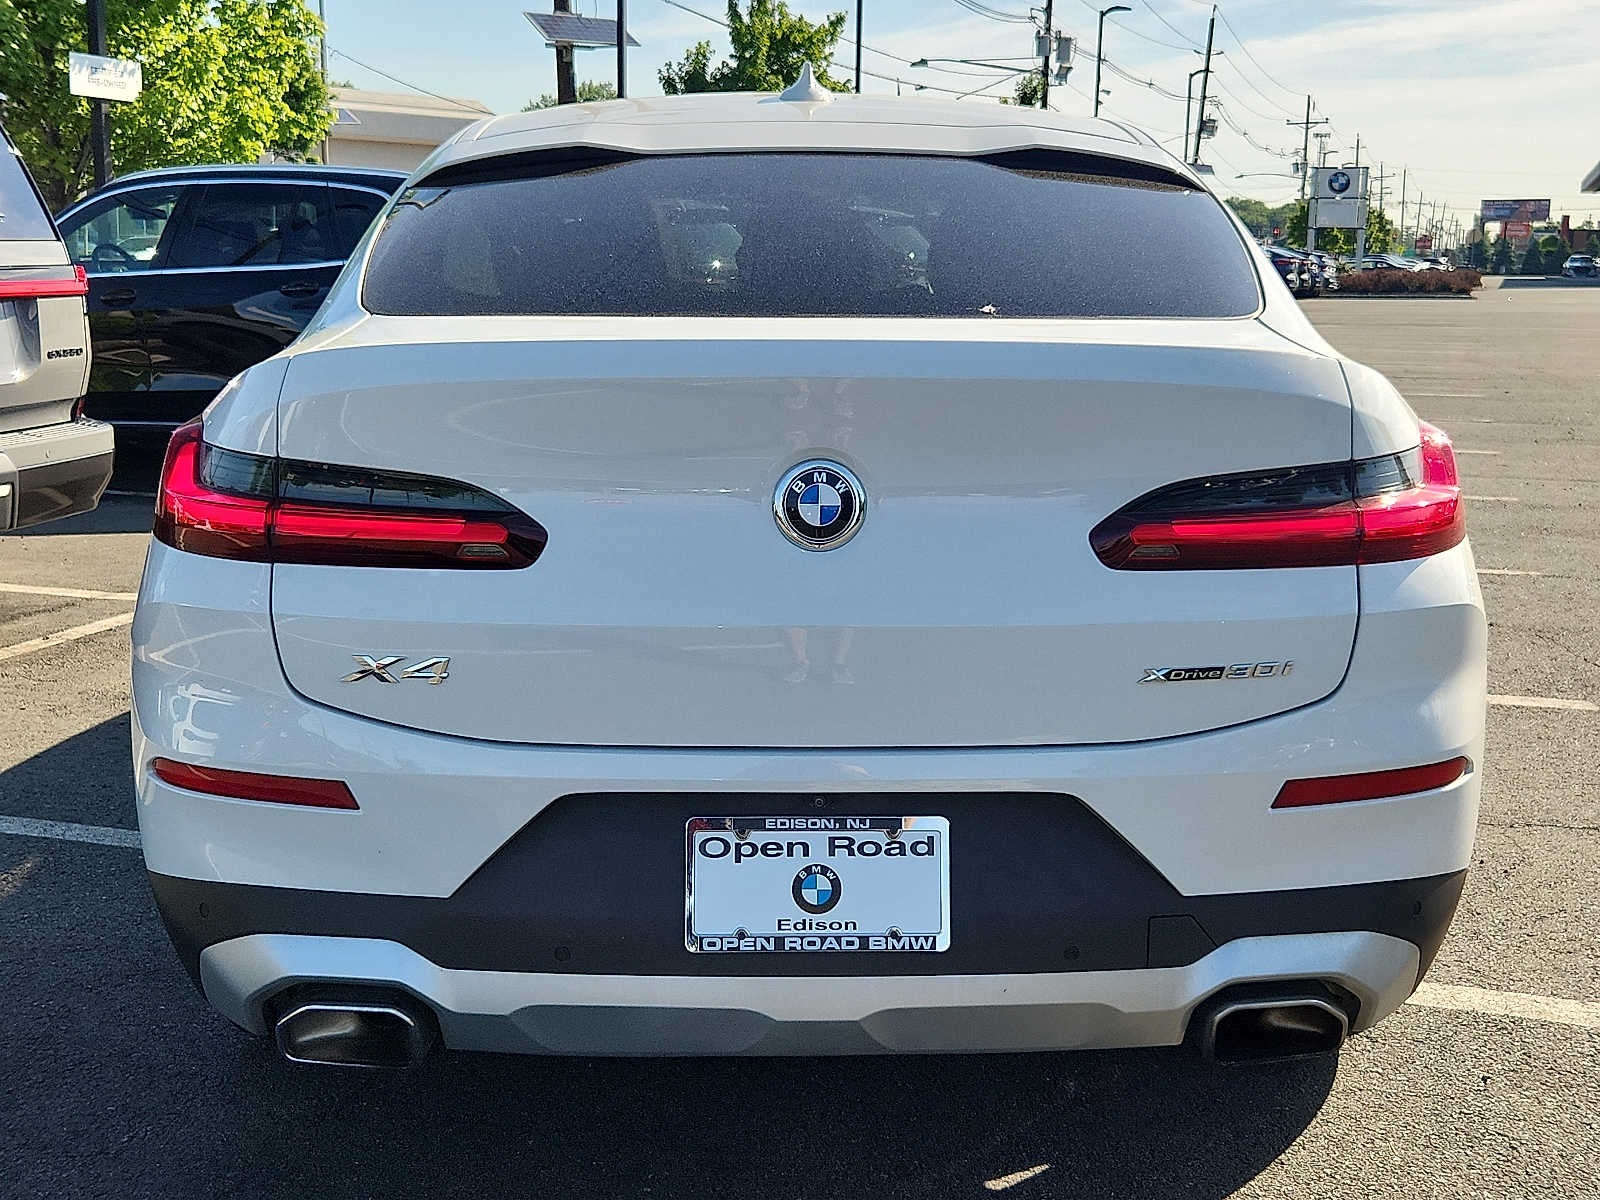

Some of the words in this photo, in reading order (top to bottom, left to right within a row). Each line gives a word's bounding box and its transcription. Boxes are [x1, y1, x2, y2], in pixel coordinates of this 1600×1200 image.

[791, 471, 849, 494] BMW
[339, 654, 451, 686] X4
[765, 818, 840, 830] EDISON,
[846, 818, 870, 830] NJ
[698, 836, 810, 864] Open
[827, 835, 935, 858] Road
[799, 865, 837, 880] BMW
[777, 918, 857, 932] Edison
[702, 936, 775, 951] OPEN
[784, 936, 860, 951] ROAD
[868, 936, 935, 951] BMW
